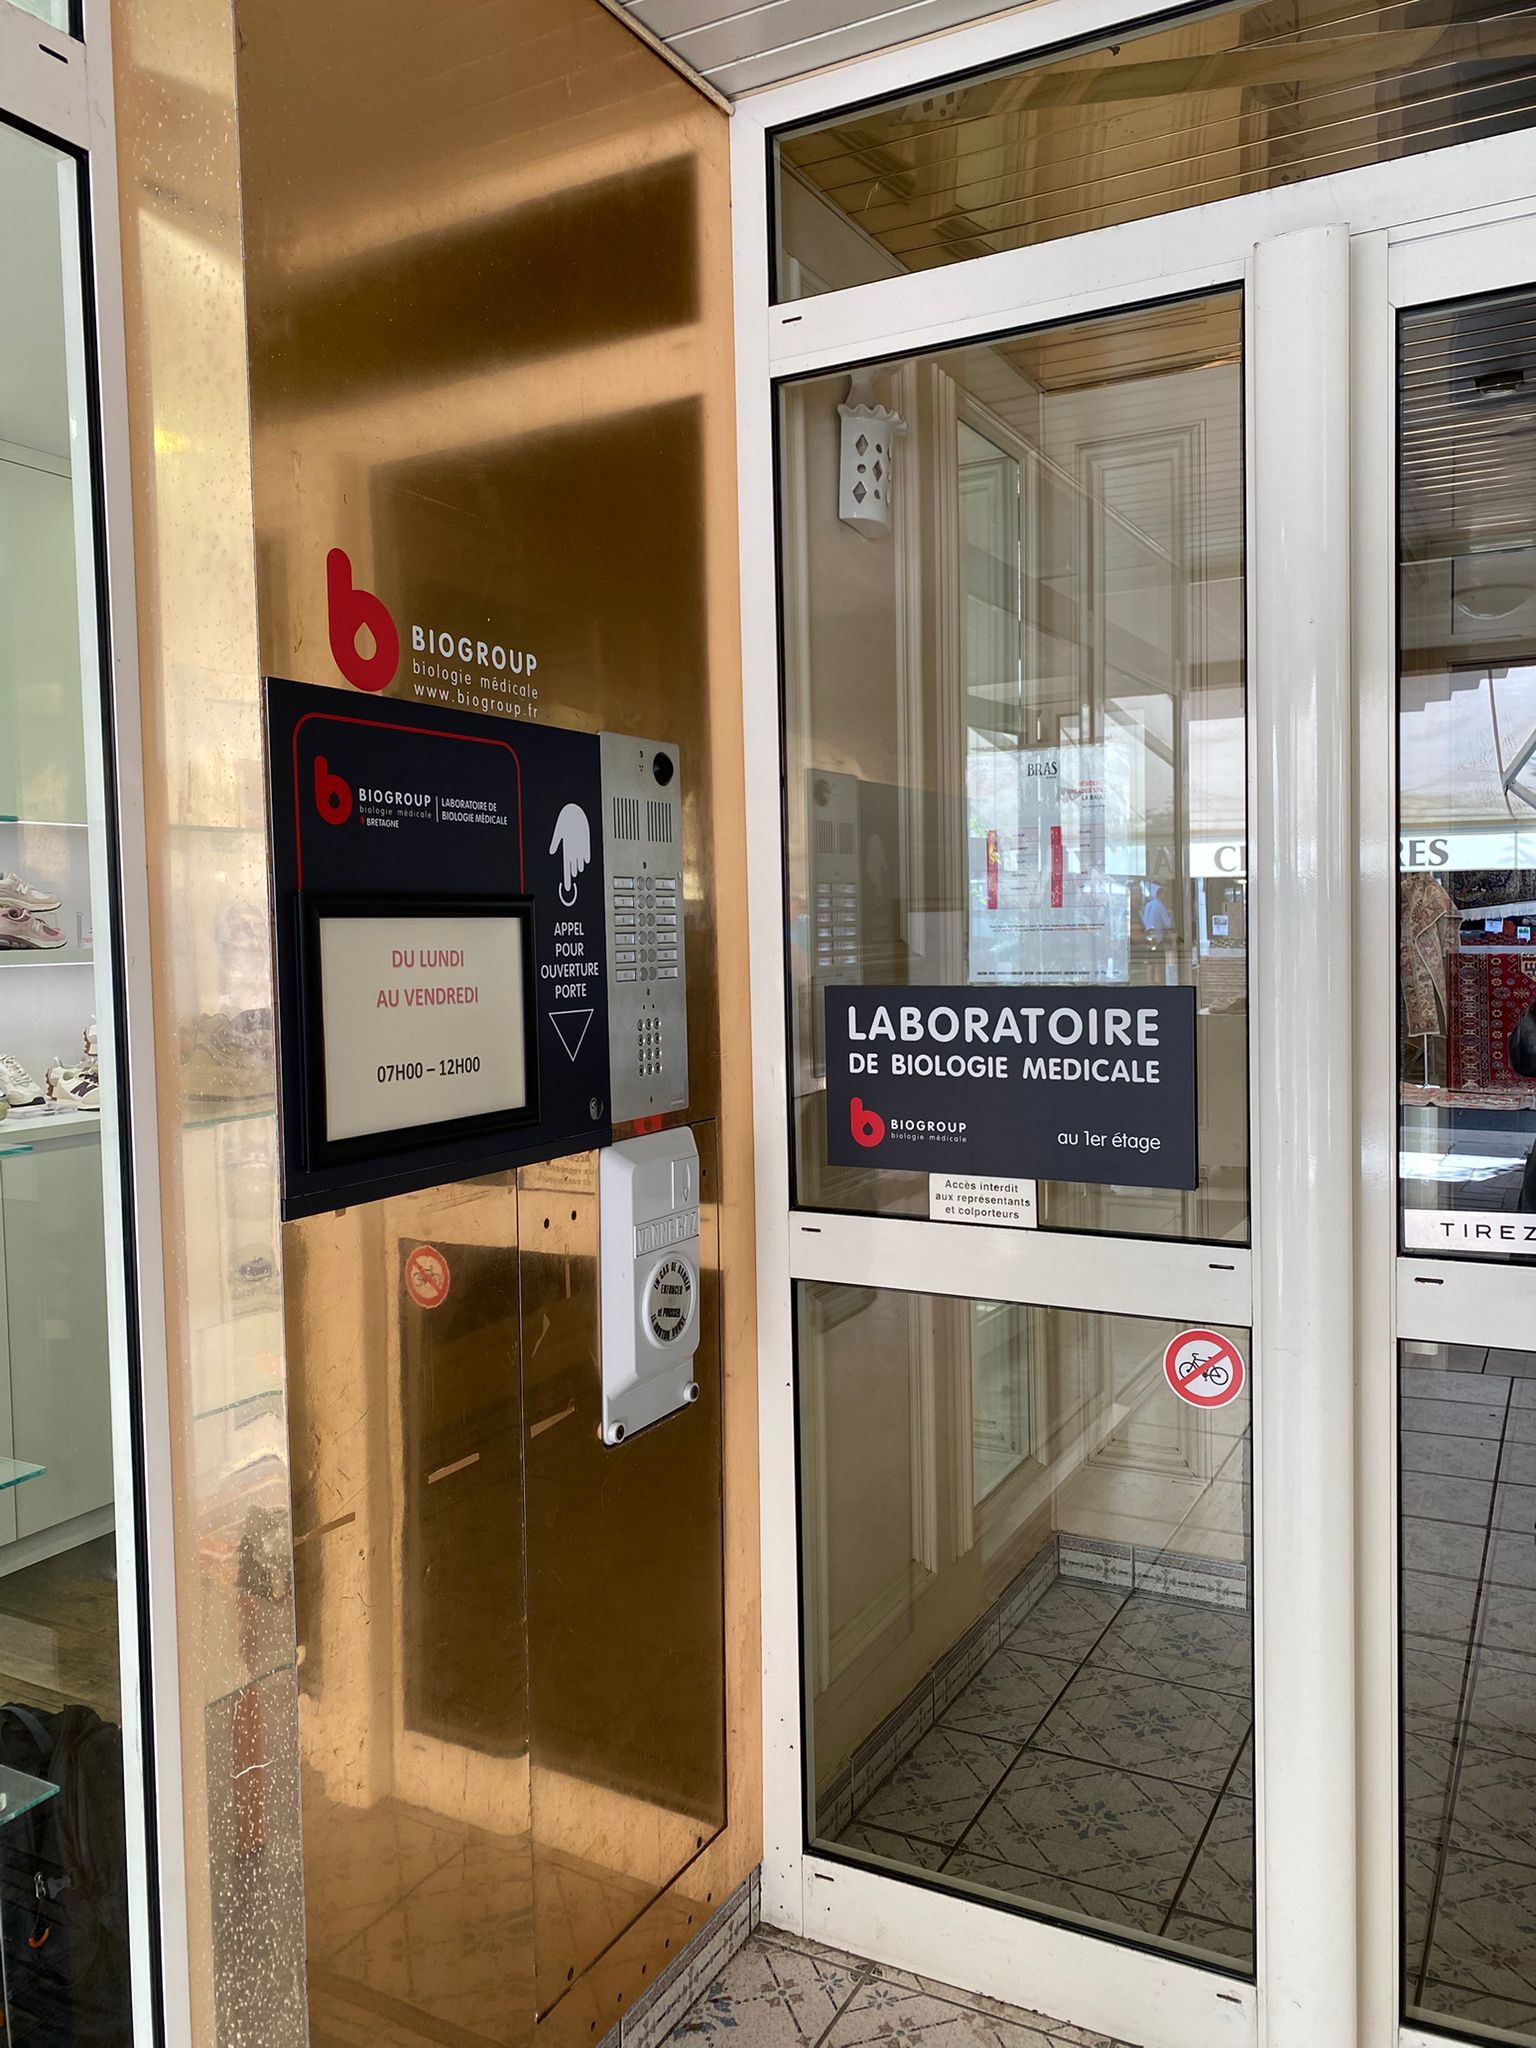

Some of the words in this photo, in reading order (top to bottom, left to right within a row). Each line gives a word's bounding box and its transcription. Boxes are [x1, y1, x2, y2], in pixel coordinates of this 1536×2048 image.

[411, 625, 537, 676] BIOGROUP
[412, 658, 472, 685] biologie
[480, 677, 538, 699] médicale
[414, 683, 538, 718] www.biogroup.fr
[1027, 761, 1058, 777] BRAS
[359, 788, 431, 807] BIOGROUP
[441, 798, 487, 812] LABORATOIRE
[488, 802, 497, 812] DE
[359, 805, 393, 816] biologie
[397, 807, 432, 819] médicale
[441, 811, 474, 823] BIOLOGIE
[474, 813, 508, 825] MÉDICALE
[366, 817, 399, 828] BRETAGNE
[553, 922, 584, 937] APPEL
[555, 942, 584, 957] POUR
[392, 950, 415, 968] DU
[419, 950, 464, 968] LUNDI
[540, 962, 599, 979] OUVERTURE
[376, 989, 399, 1008] AU
[404, 986, 478, 1006] VENDREDI
[555, 983, 587, 999] PORTE
[848, 1005, 1159, 1047] LABORATOIRE
[377, 1062, 423, 1083] 07H00
[439, 1056, 481, 1076] 12H00
[849, 1052, 879, 1075] DE
[891, 1053, 1008, 1079] BIOLOGIE
[1022, 1057, 1160, 1084] MEDICALE
[890, 1118, 967, 1133] BIOGROUP
[890, 1131, 925, 1143] biologie
[928, 1132, 967, 1143] médicale
[1057, 1132, 1078, 1145] au
[1084, 1130, 1107, 1147] 1er
[1111, 1131, 1161, 1153] étage
[945, 1180, 976, 1190] Accès
[980, 1182, 1018, 1193] interdit
[935, 1193, 954, 1201] aux
[957, 1194, 1031, 1207] représentants
[945, 1206, 955, 1214] et
[958, 1207, 1020, 1219] colporteurs
[1440, 1222, 1536, 1241] TIREZ
[659, 1263, 670, 1279] CAS
